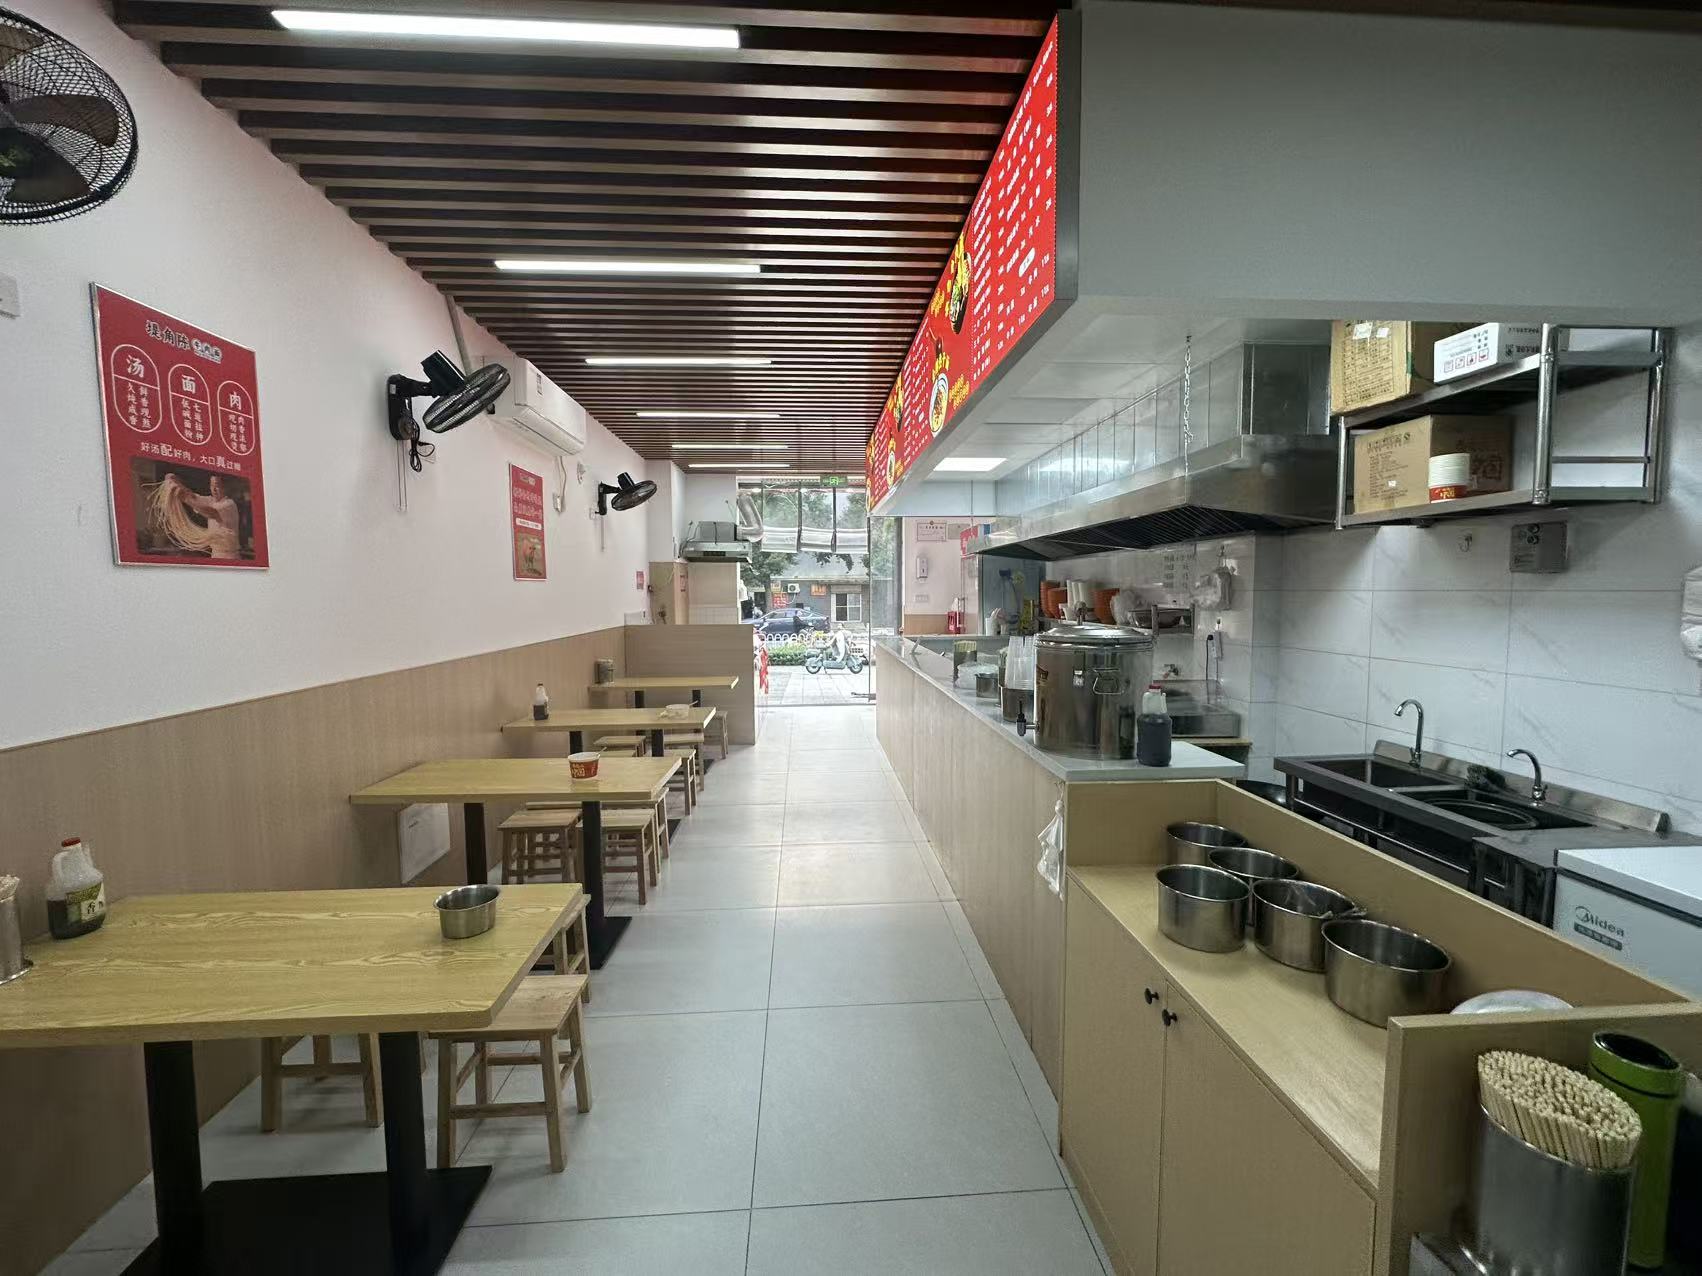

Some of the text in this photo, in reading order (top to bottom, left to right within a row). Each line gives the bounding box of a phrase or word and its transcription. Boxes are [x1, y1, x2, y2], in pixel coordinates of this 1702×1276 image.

[126, 355, 144, 378] 汤
[182, 374, 195, 394] 面
[229, 391, 242, 410] 肉
[1577, 907, 1624, 937] Midea
